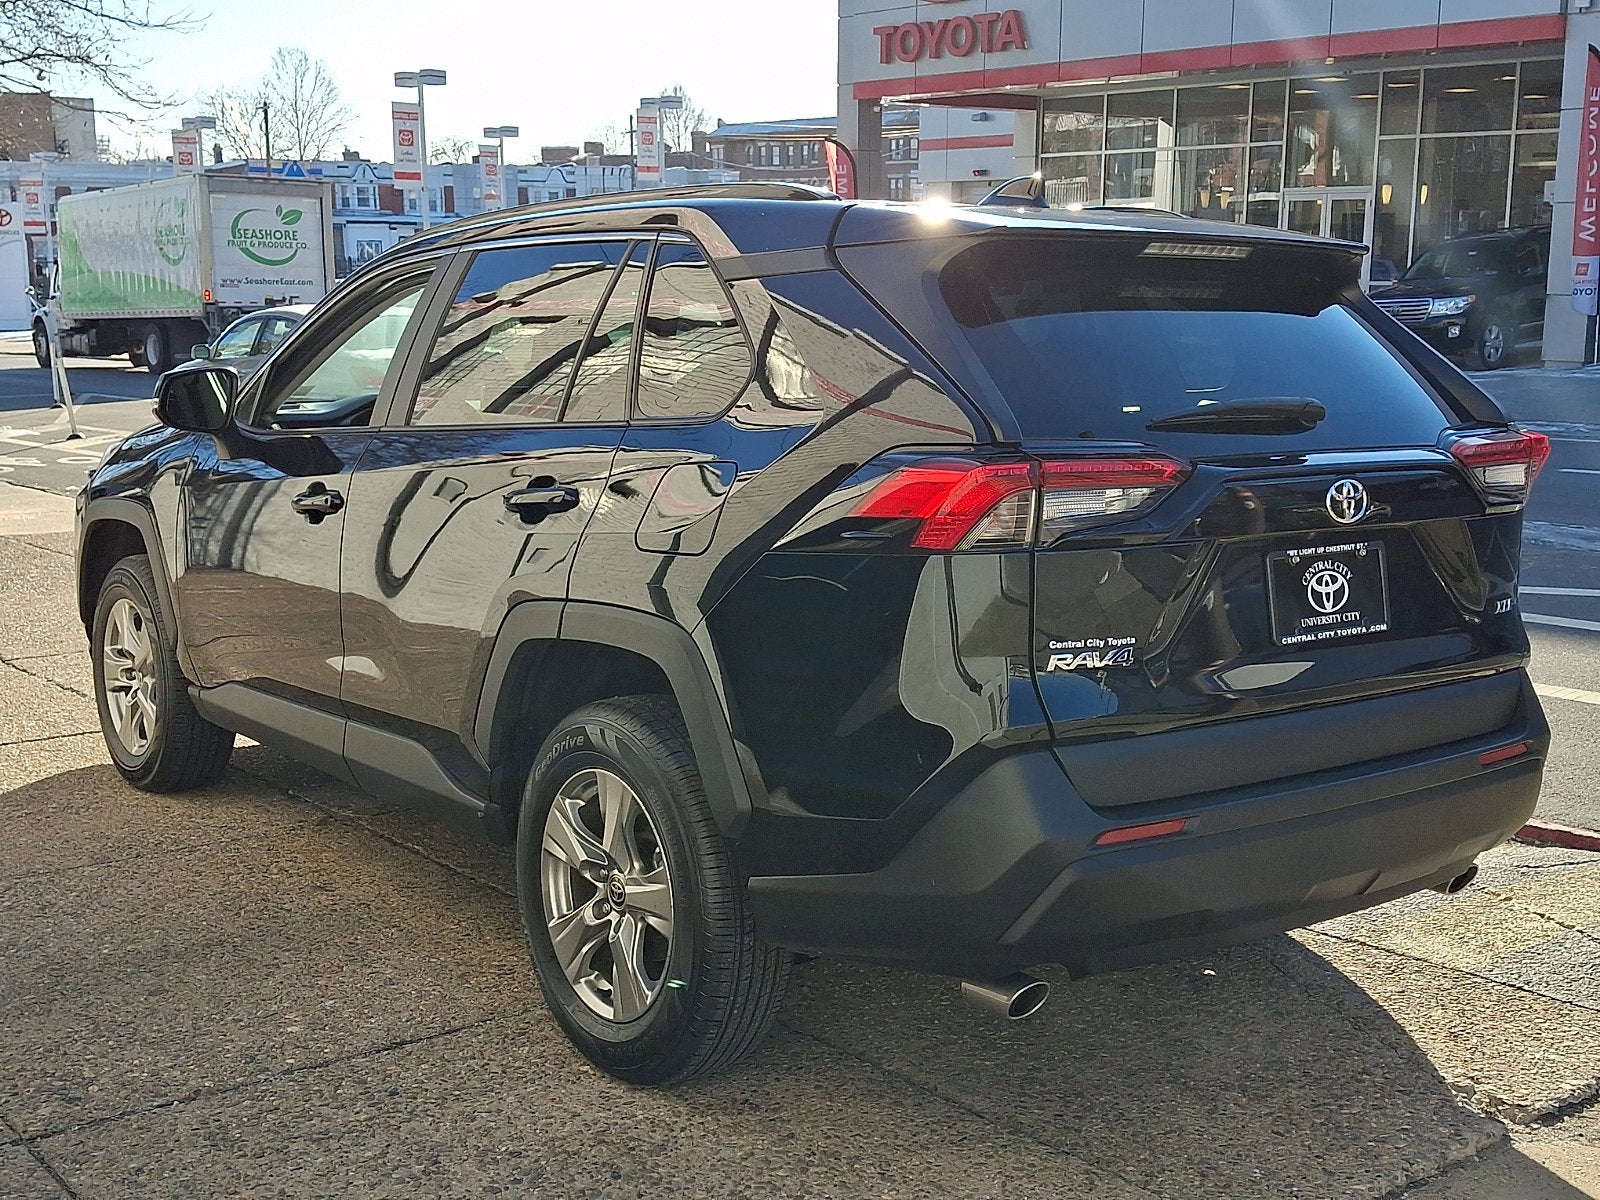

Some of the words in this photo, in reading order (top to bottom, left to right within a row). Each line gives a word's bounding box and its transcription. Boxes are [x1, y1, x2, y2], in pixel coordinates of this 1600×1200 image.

[873, 10, 1028, 64] TOYOTA
[237, 228, 298, 241] SEASHORE
[227, 239, 248, 248] FRUIT
[258, 240, 294, 249] PRODUCE
[295, 242, 310, 250] CO.
[220, 277, 314, 286] www.SeashoreEast.com
[1299, 547, 1316, 556] LIGHT
[1316, 546, 1325, 554] UP
[1325, 543, 1356, 553] CHESTNUT
[1302, 560, 1334, 586] CENTRAL
[1334, 561, 1354, 581] CITY
[1301, 613, 1342, 628] UNIVERSITY
[1342, 611, 1361, 622] CITY
[1049, 639, 1085, 649] Central
[1086, 638, 1105, 648] City
[1107, 636, 1136, 647] Toyota
[1281, 633, 1316, 645] CENTRAL
[1317, 630, 1335, 640] CITY
[1336, 626, 1367, 637] TOYOTA
[1368, 623, 1387, 633] .COM
[1046, 647, 1134, 672] RAV4
[535, 735, 585, 781] GeoDrive
